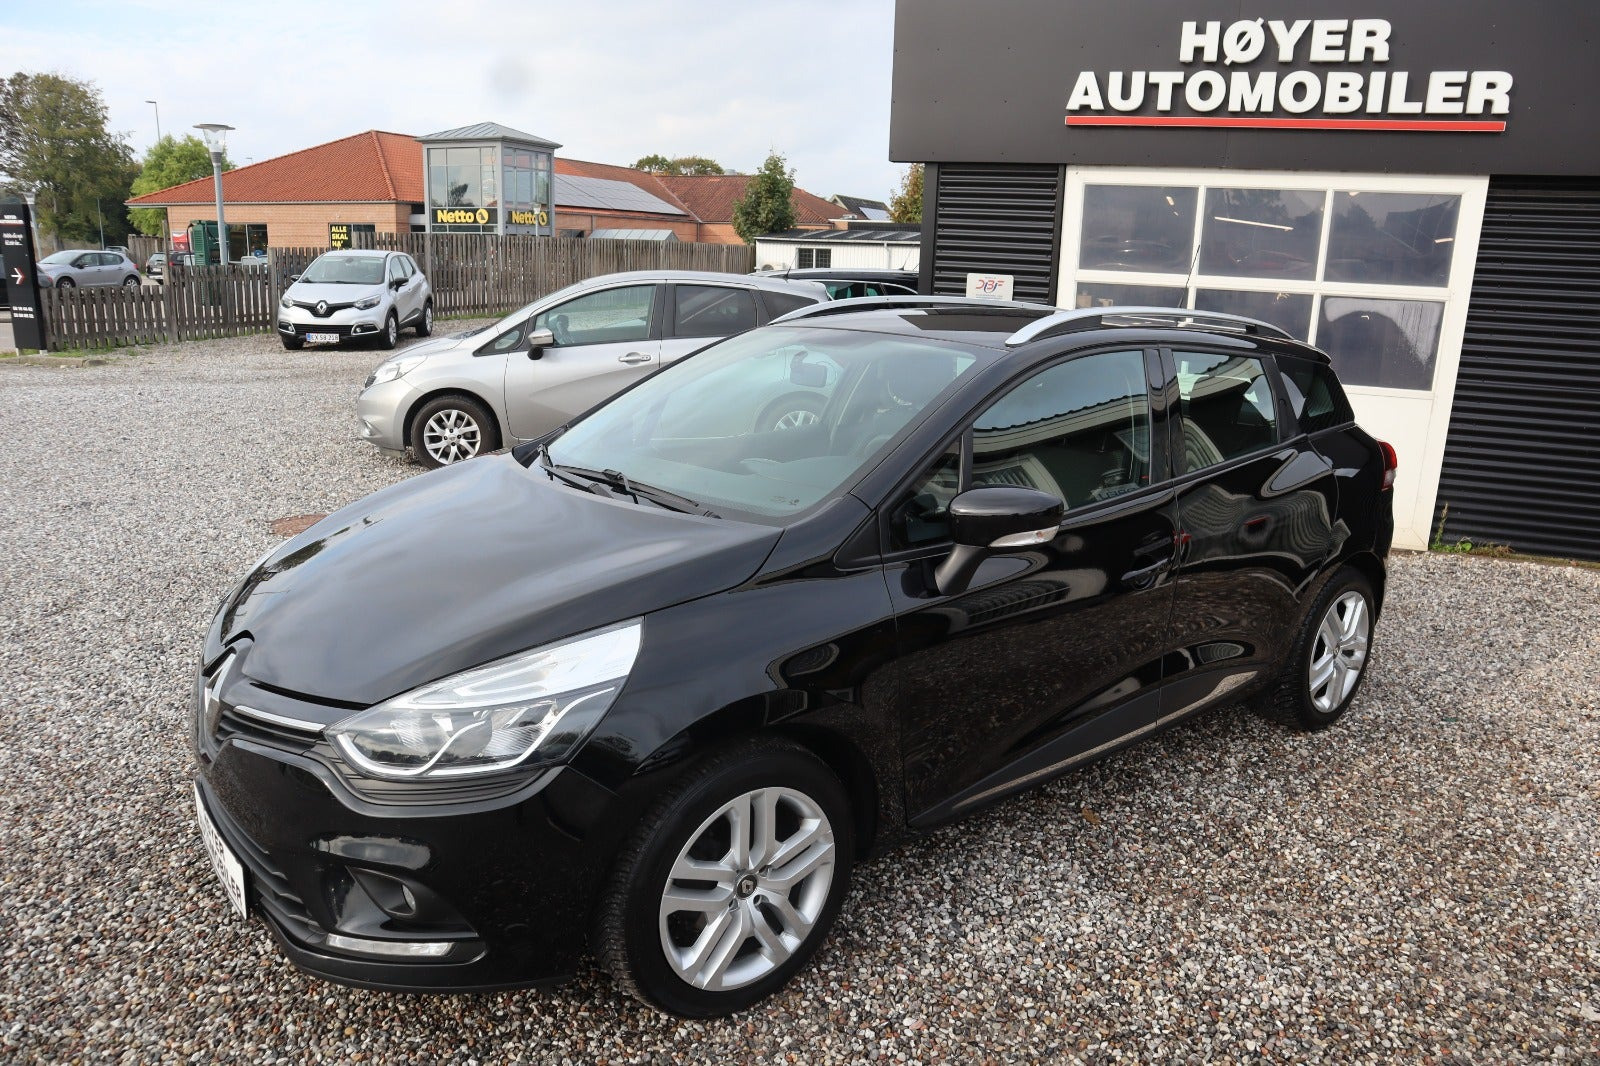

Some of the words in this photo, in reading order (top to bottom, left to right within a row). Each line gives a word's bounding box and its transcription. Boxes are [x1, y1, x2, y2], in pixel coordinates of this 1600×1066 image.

[1179, 17, 1392, 66] HØYER
[1065, 69, 1514, 115] AUTOMOBILER
[437, 209, 475, 223] Netto
